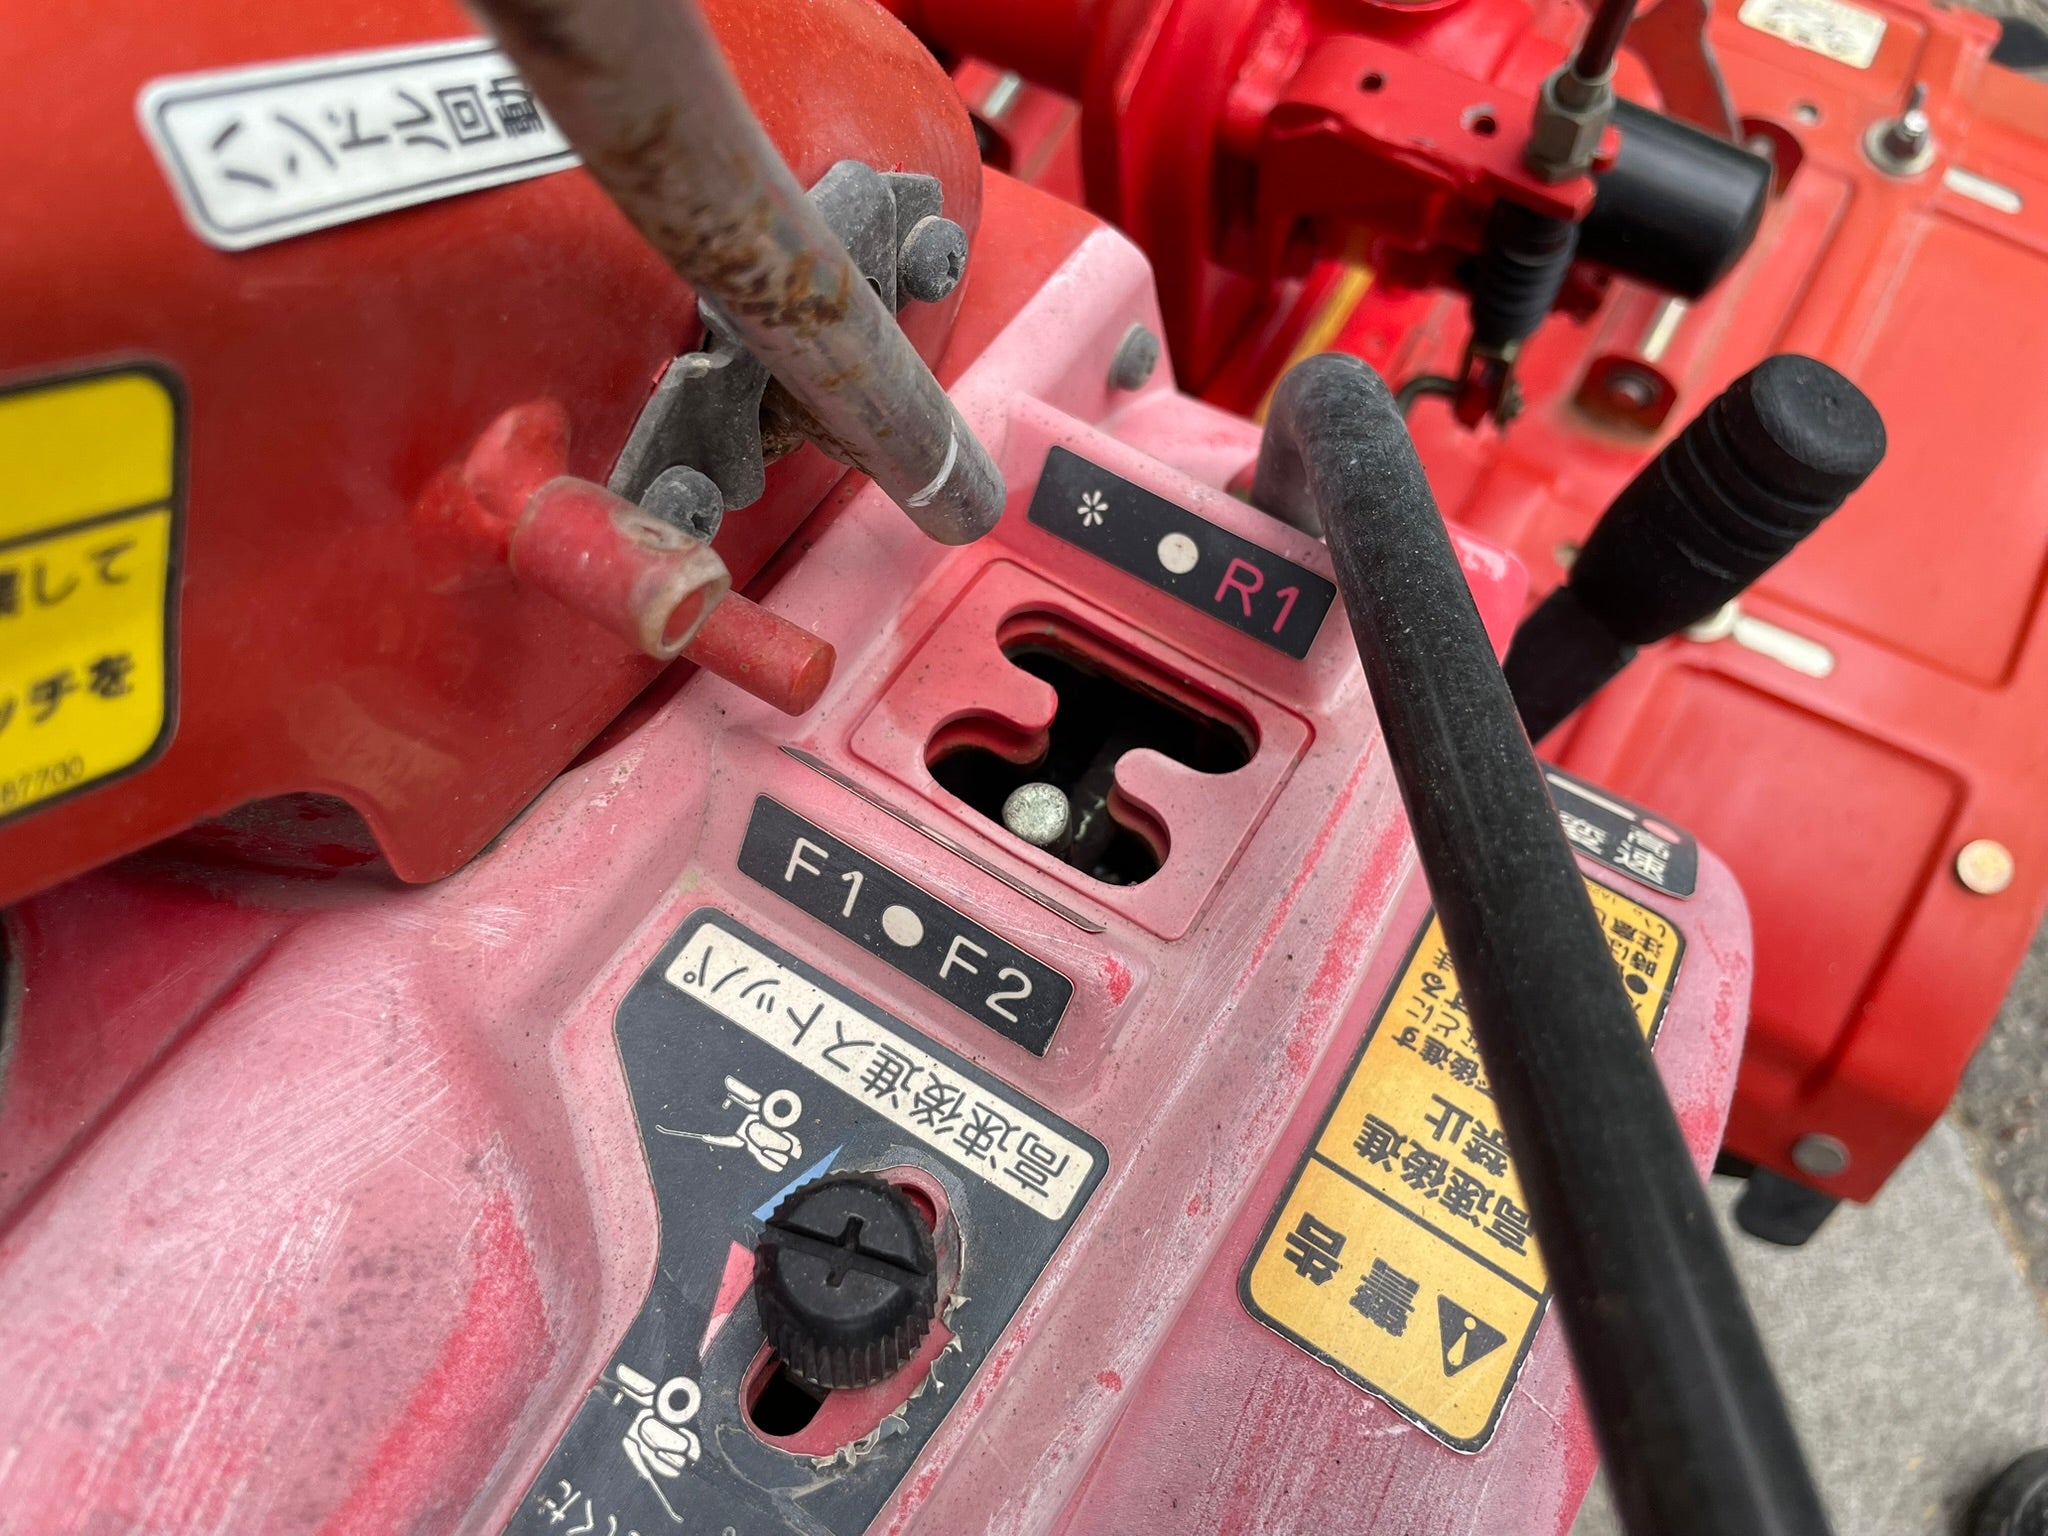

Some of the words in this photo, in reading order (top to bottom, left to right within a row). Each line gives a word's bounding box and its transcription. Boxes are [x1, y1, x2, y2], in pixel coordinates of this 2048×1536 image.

[1215, 557, 1300, 634] R1
[784, 837, 865, 918] F1
[939, 934, 1034, 1024] F2
[683, 944, 1070, 1199] 高速後進ストッパ
[1423, 1092, 1511, 1178] 禁止
[1352, 1112, 1537, 1257] 高速後進
[1283, 1210, 1422, 1338] 警告
